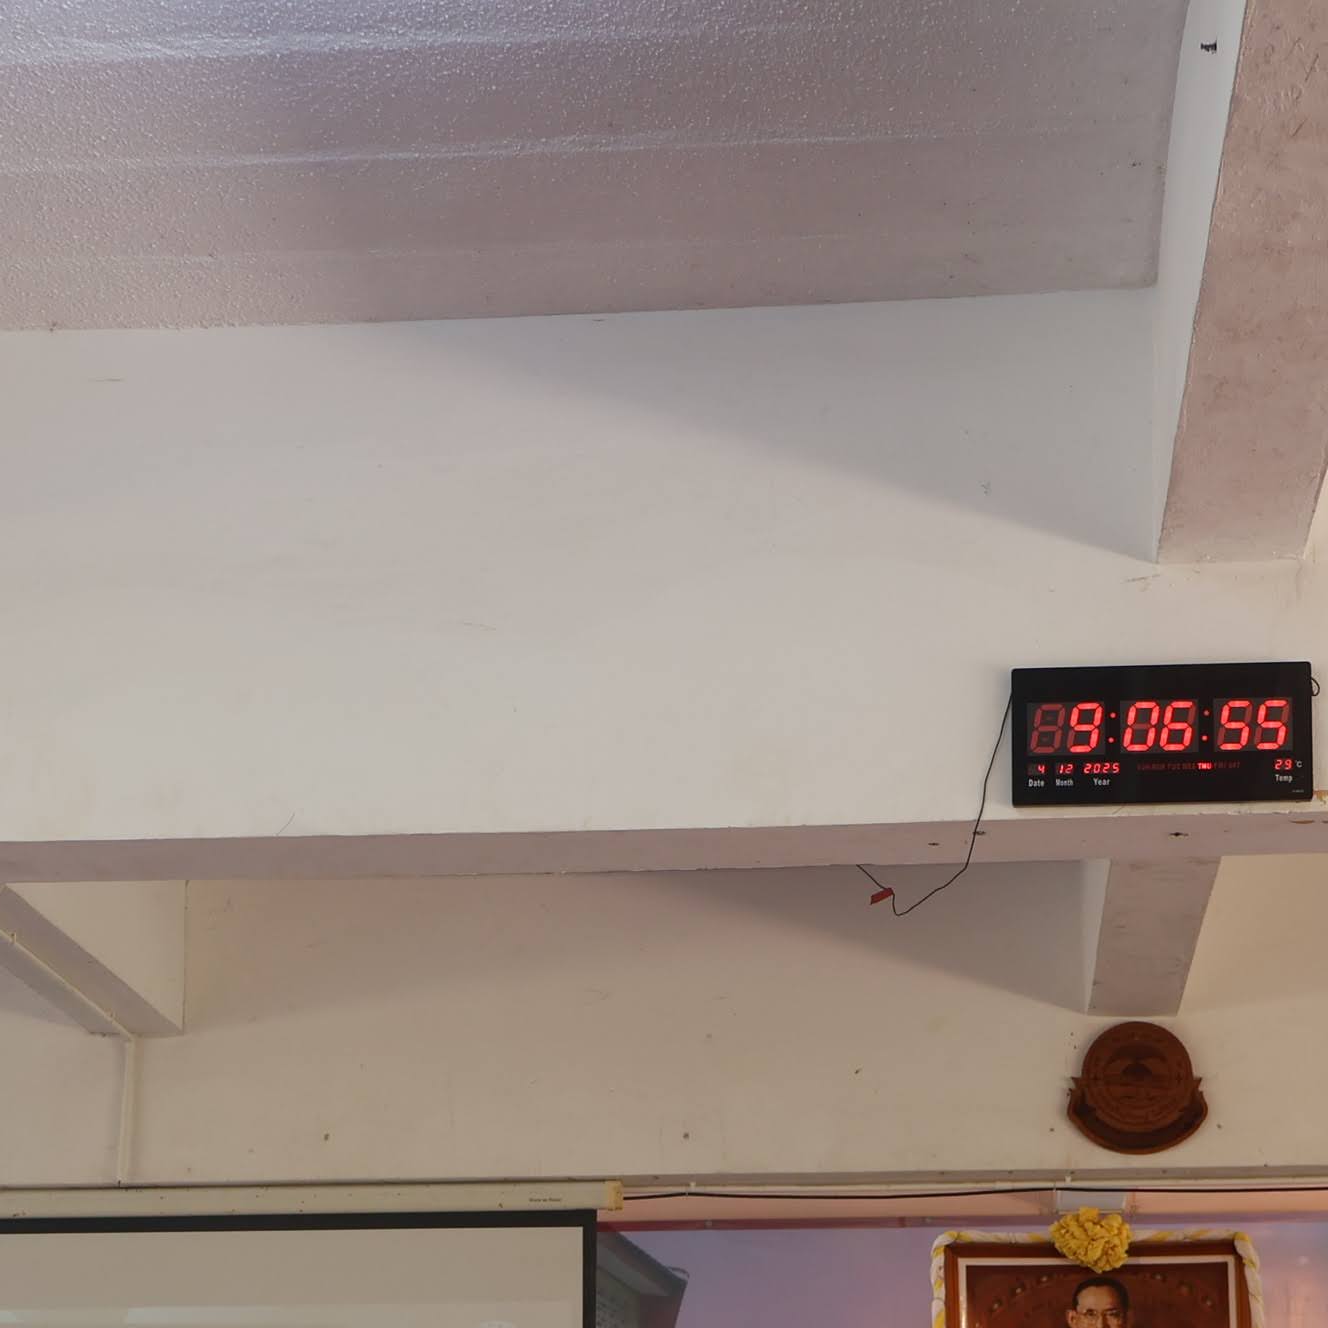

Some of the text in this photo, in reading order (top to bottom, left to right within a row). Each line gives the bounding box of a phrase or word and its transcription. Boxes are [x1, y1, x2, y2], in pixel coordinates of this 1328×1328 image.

[1083, 762, 1120, 774] 2025
[1274, 759, 1293, 770] 29
[1028, 779, 1045, 787] Date
[1093, 777, 1110, 786] Year
[1275, 774, 1293, 783] Temp
